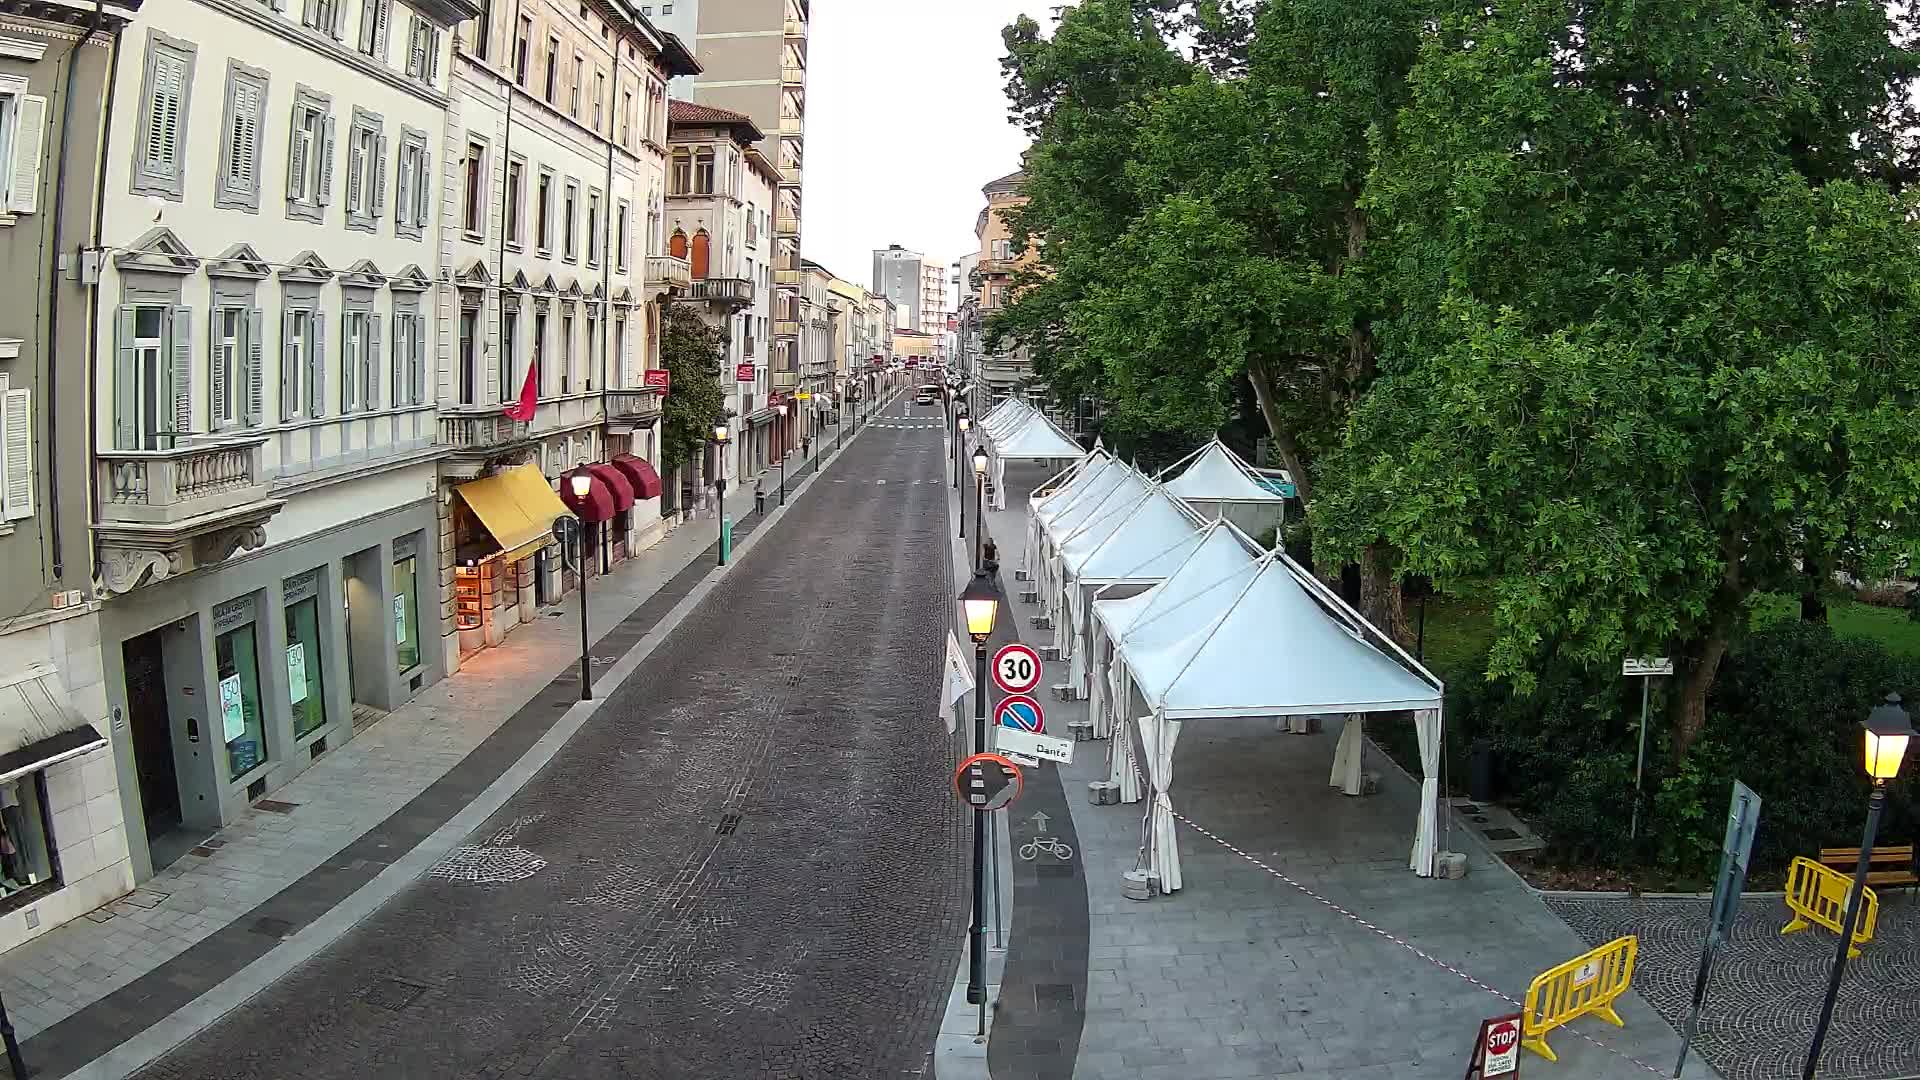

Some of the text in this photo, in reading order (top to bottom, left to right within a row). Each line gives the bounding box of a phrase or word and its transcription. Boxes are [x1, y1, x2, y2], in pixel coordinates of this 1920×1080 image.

[1004, 658, 1031, 680] 30
[1036, 744, 1067, 758] Dante
[1488, 1030, 1516, 1048] STOP
